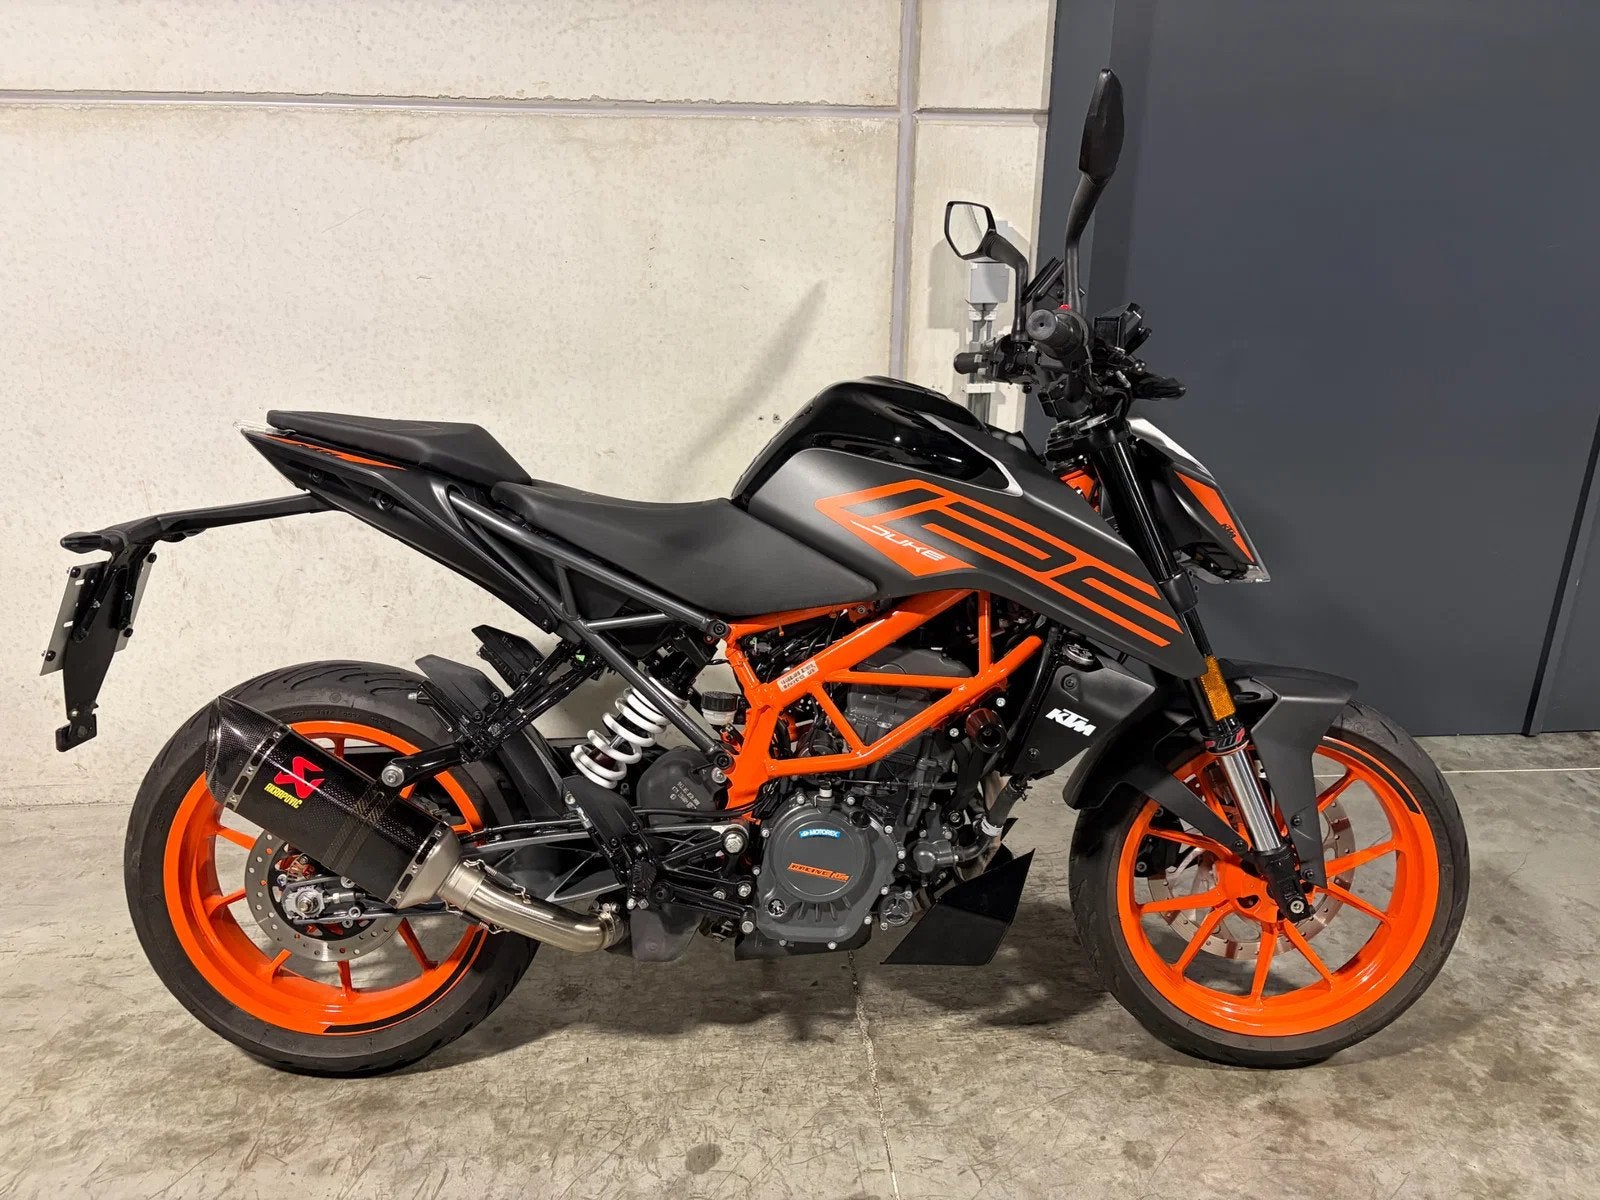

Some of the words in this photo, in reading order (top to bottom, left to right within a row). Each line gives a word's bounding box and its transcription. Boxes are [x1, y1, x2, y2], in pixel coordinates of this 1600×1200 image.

[850, 519, 947, 562] DUKE
[1045, 707, 1097, 737] KTM
[809, 828, 839, 838] MOTOREX
